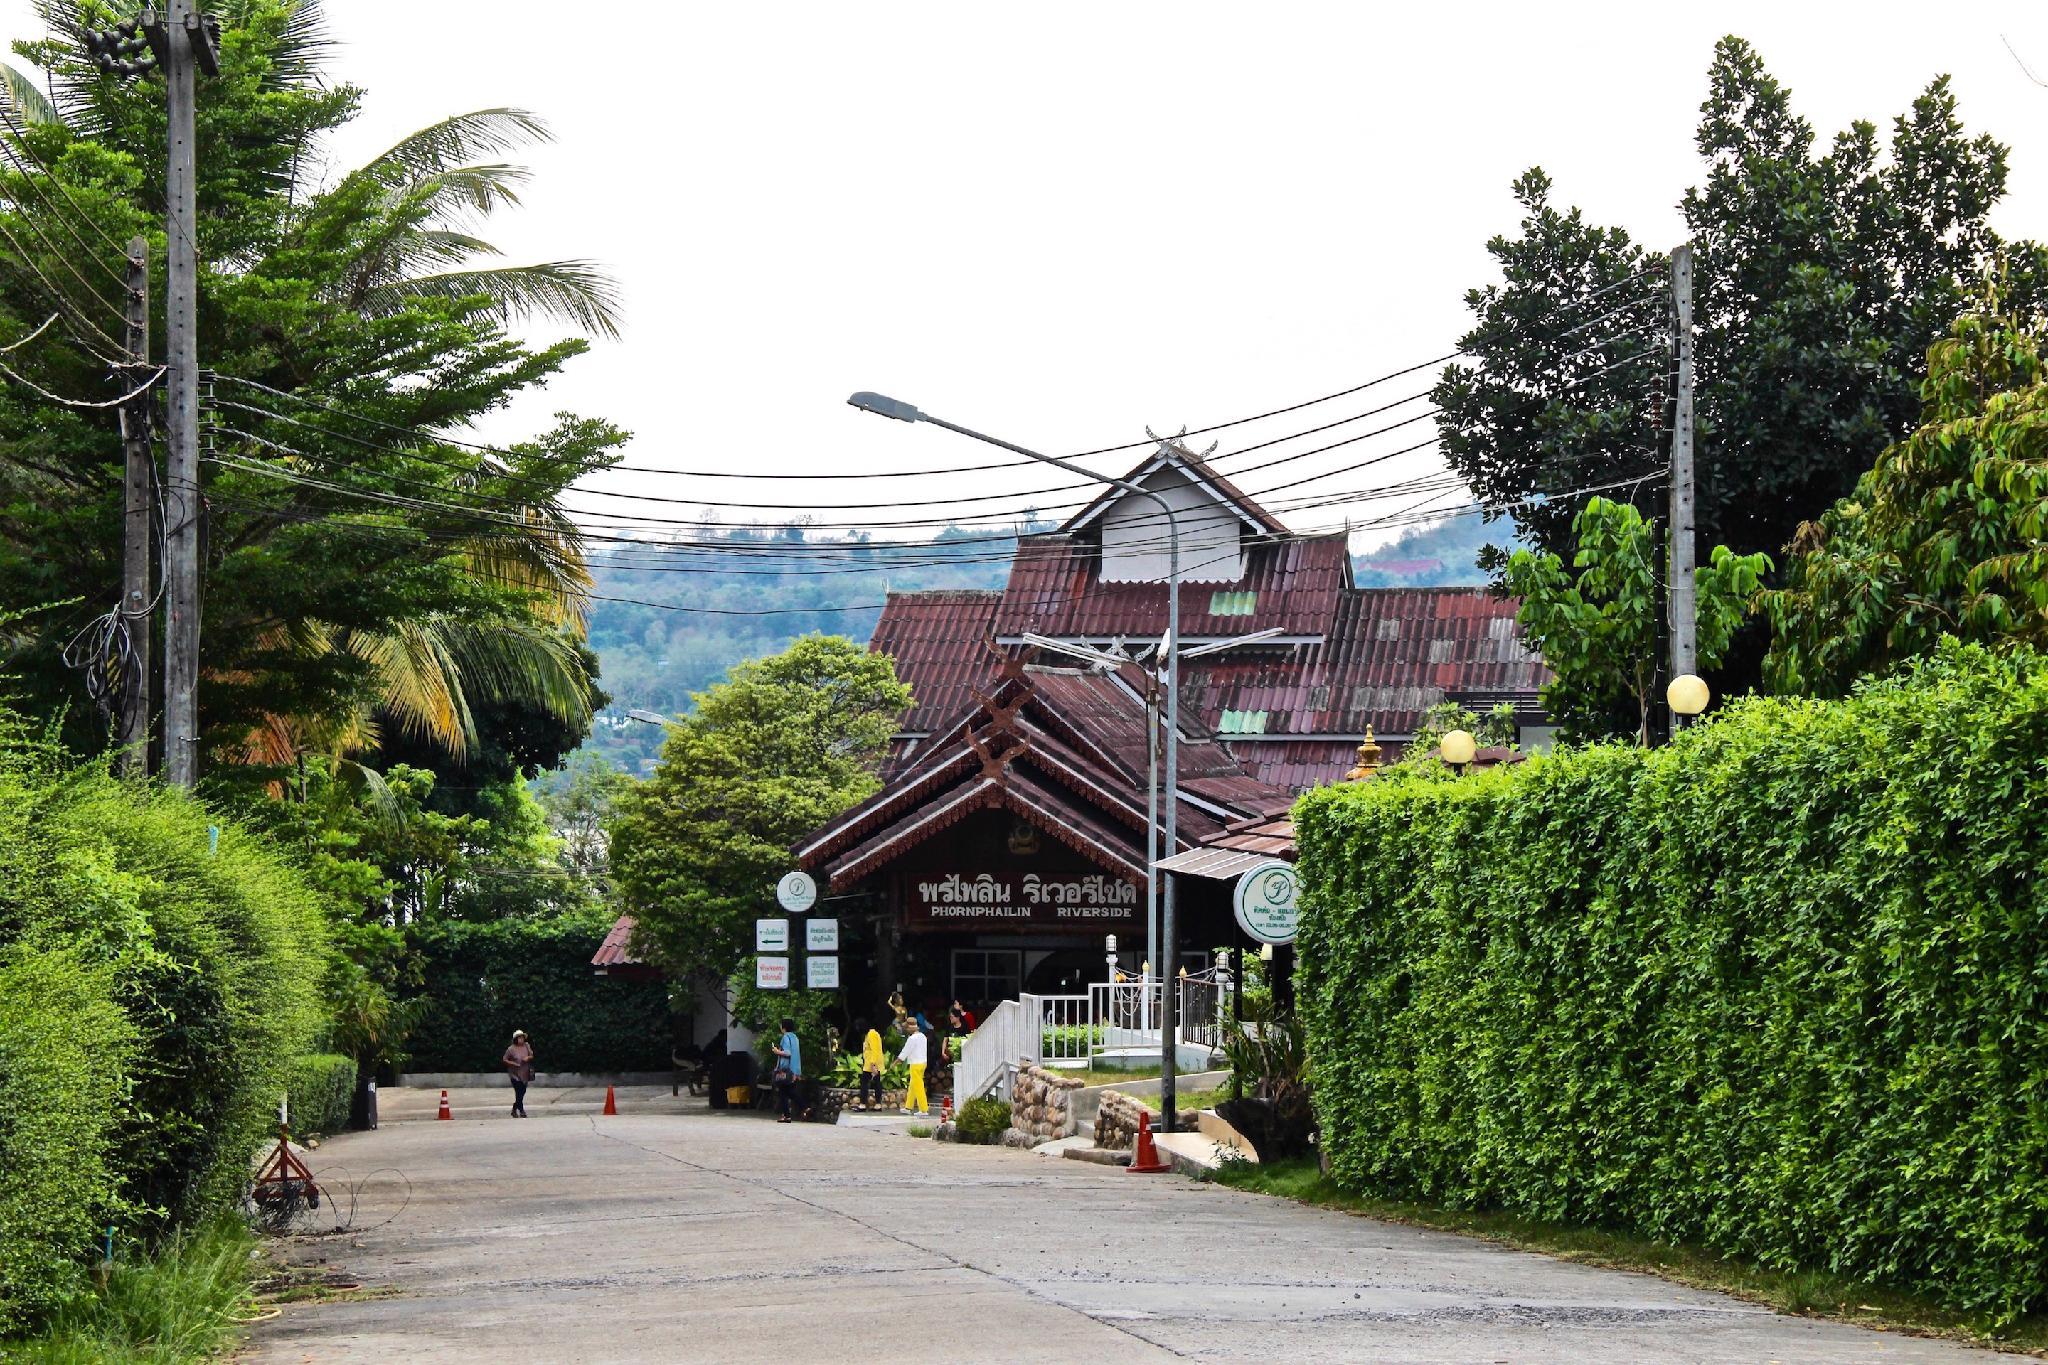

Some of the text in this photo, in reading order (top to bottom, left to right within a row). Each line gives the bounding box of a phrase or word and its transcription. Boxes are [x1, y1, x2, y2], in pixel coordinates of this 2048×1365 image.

[918, 873, 1011, 903] พรไพลิน
[931, 906, 1132, 917] PHORNPHAILIN RIVERSIDE
